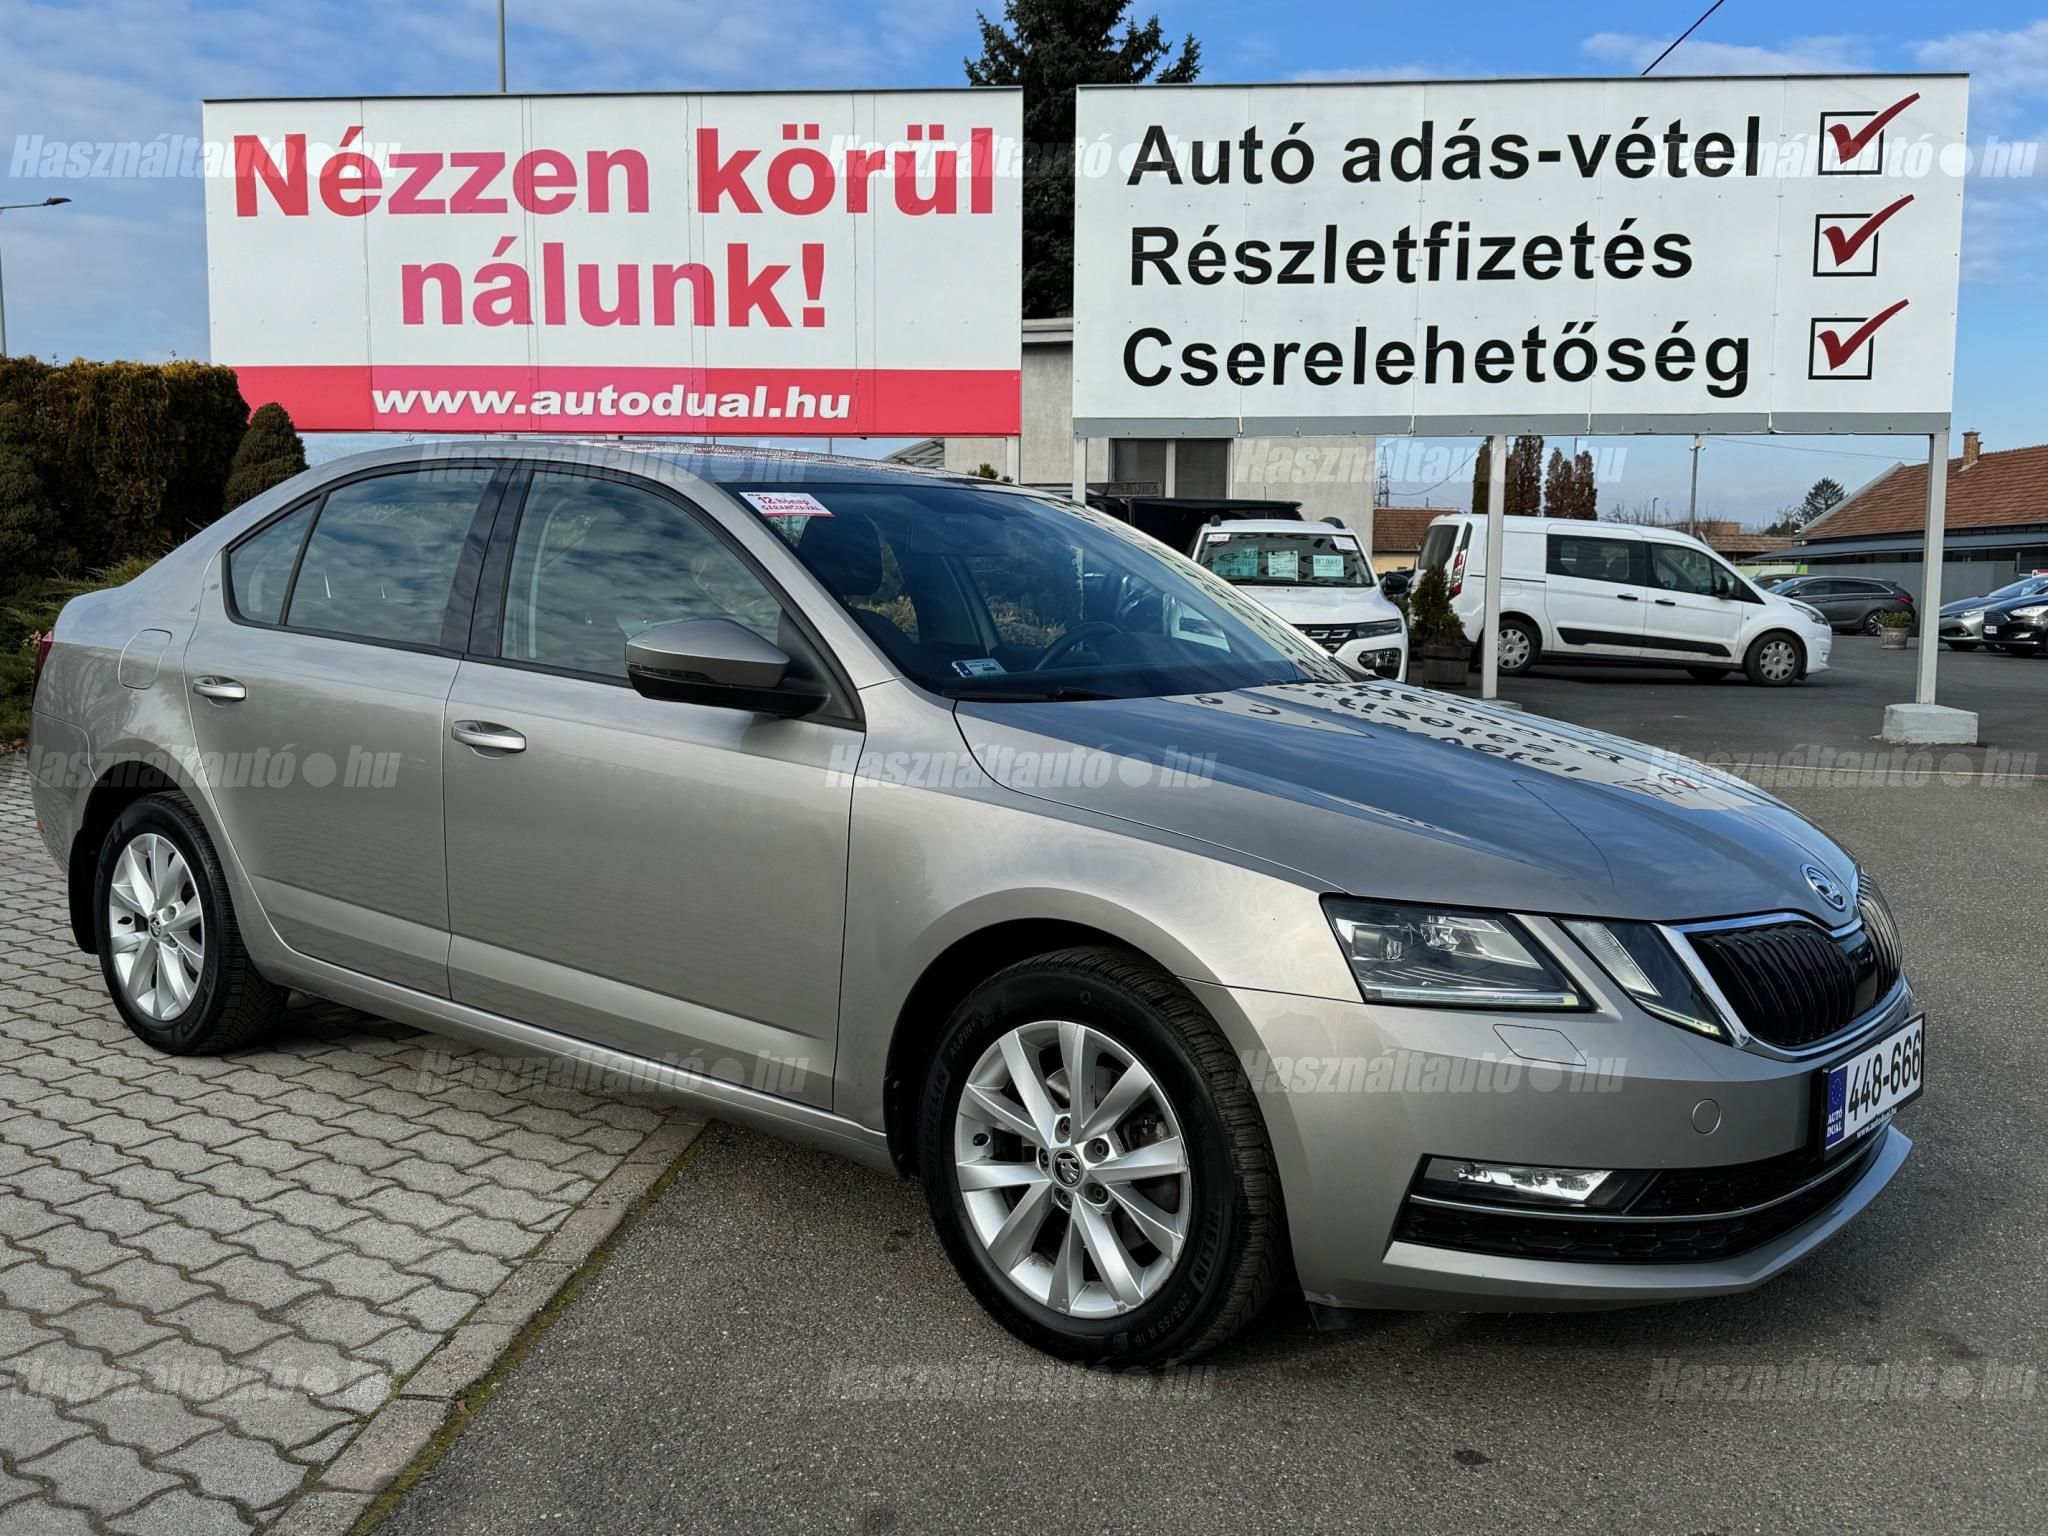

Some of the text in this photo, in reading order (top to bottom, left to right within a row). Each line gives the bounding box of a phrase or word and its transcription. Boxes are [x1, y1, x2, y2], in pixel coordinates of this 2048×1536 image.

[234, 123, 993, 217] Nézzen körül
[1127, 116, 1760, 186] Autó adás-vétel
[402, 237, 825, 328] nálunk!
[1131, 217, 1692, 286] Részletfizetés
[1123, 320, 1749, 399] Cserelehetőség
[372, 384, 850, 420] www.autodual.hu
[758, 496, 776, 504] 12
[1848, 1029, 1921, 1122] 448-666
[1826, 1123, 1843, 1138] DUAL
